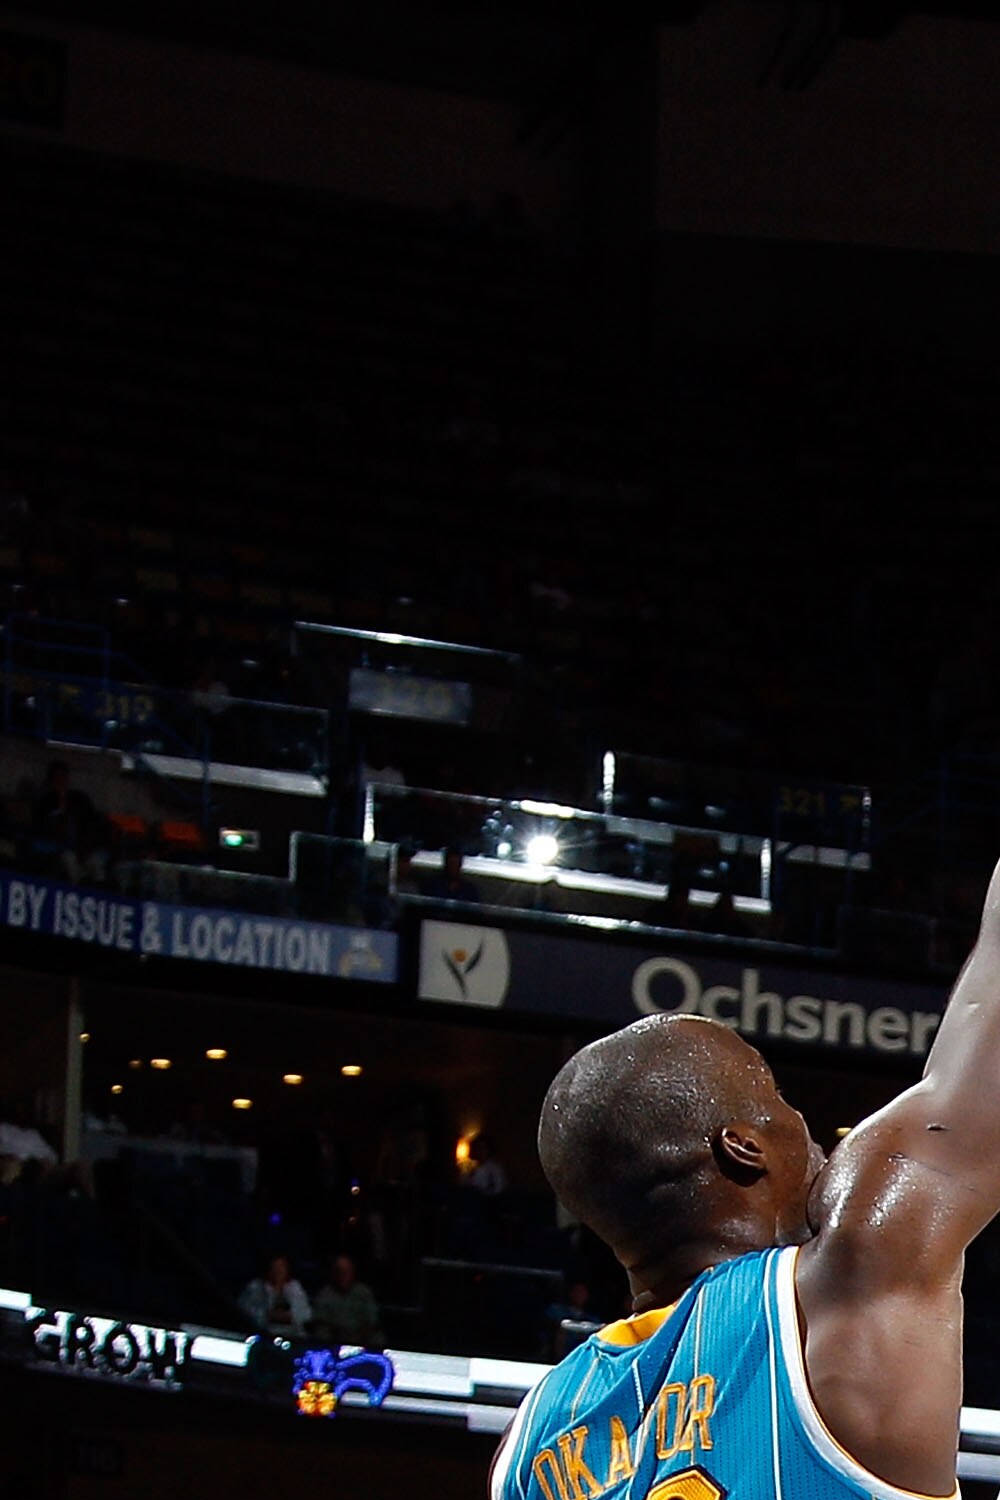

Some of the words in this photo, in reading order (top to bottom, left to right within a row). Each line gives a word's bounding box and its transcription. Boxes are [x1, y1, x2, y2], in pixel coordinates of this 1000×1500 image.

[7, 880, 48, 932] BY
[53, 892, 136, 952] ISSUE
[139, 901, 163, 954] &
[172, 910, 331, 976] LOCATION
[631, 955, 940, 1057] Ochsner
